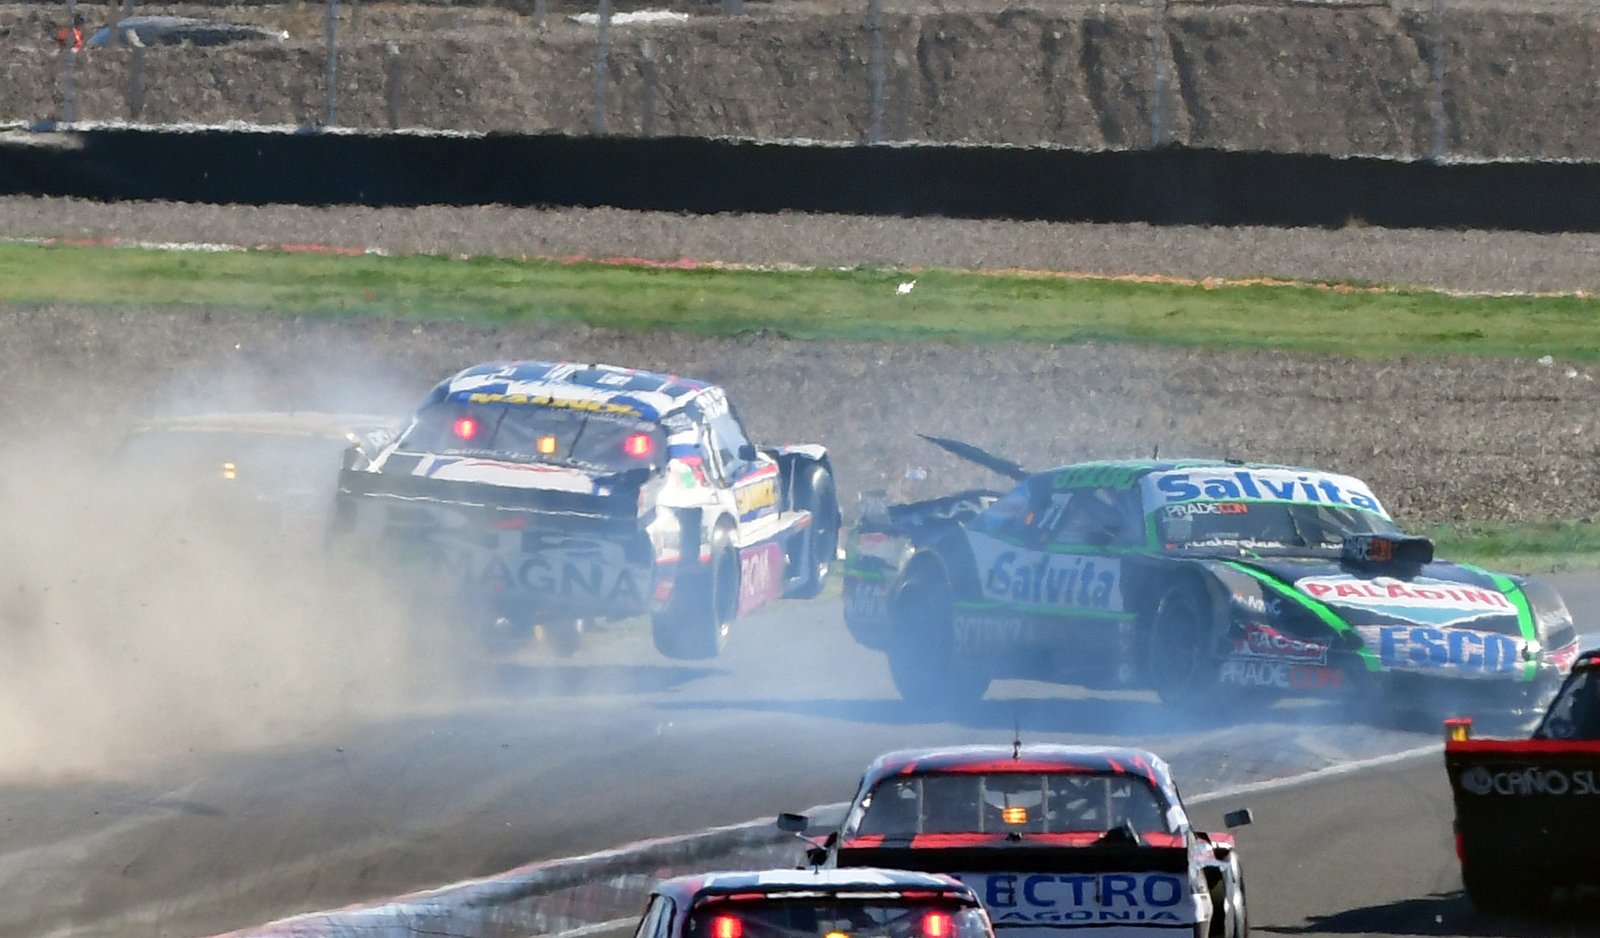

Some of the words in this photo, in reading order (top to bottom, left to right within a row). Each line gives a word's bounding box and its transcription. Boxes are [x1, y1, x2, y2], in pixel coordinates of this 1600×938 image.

[1157, 472, 1380, 512] Salvita
[430, 550, 645, 604] MAGNA
[988, 552, 1115, 607] Salvita
[1305, 583, 1509, 608] PALADINI
[1495, 766, 1569, 795] CAÑO
